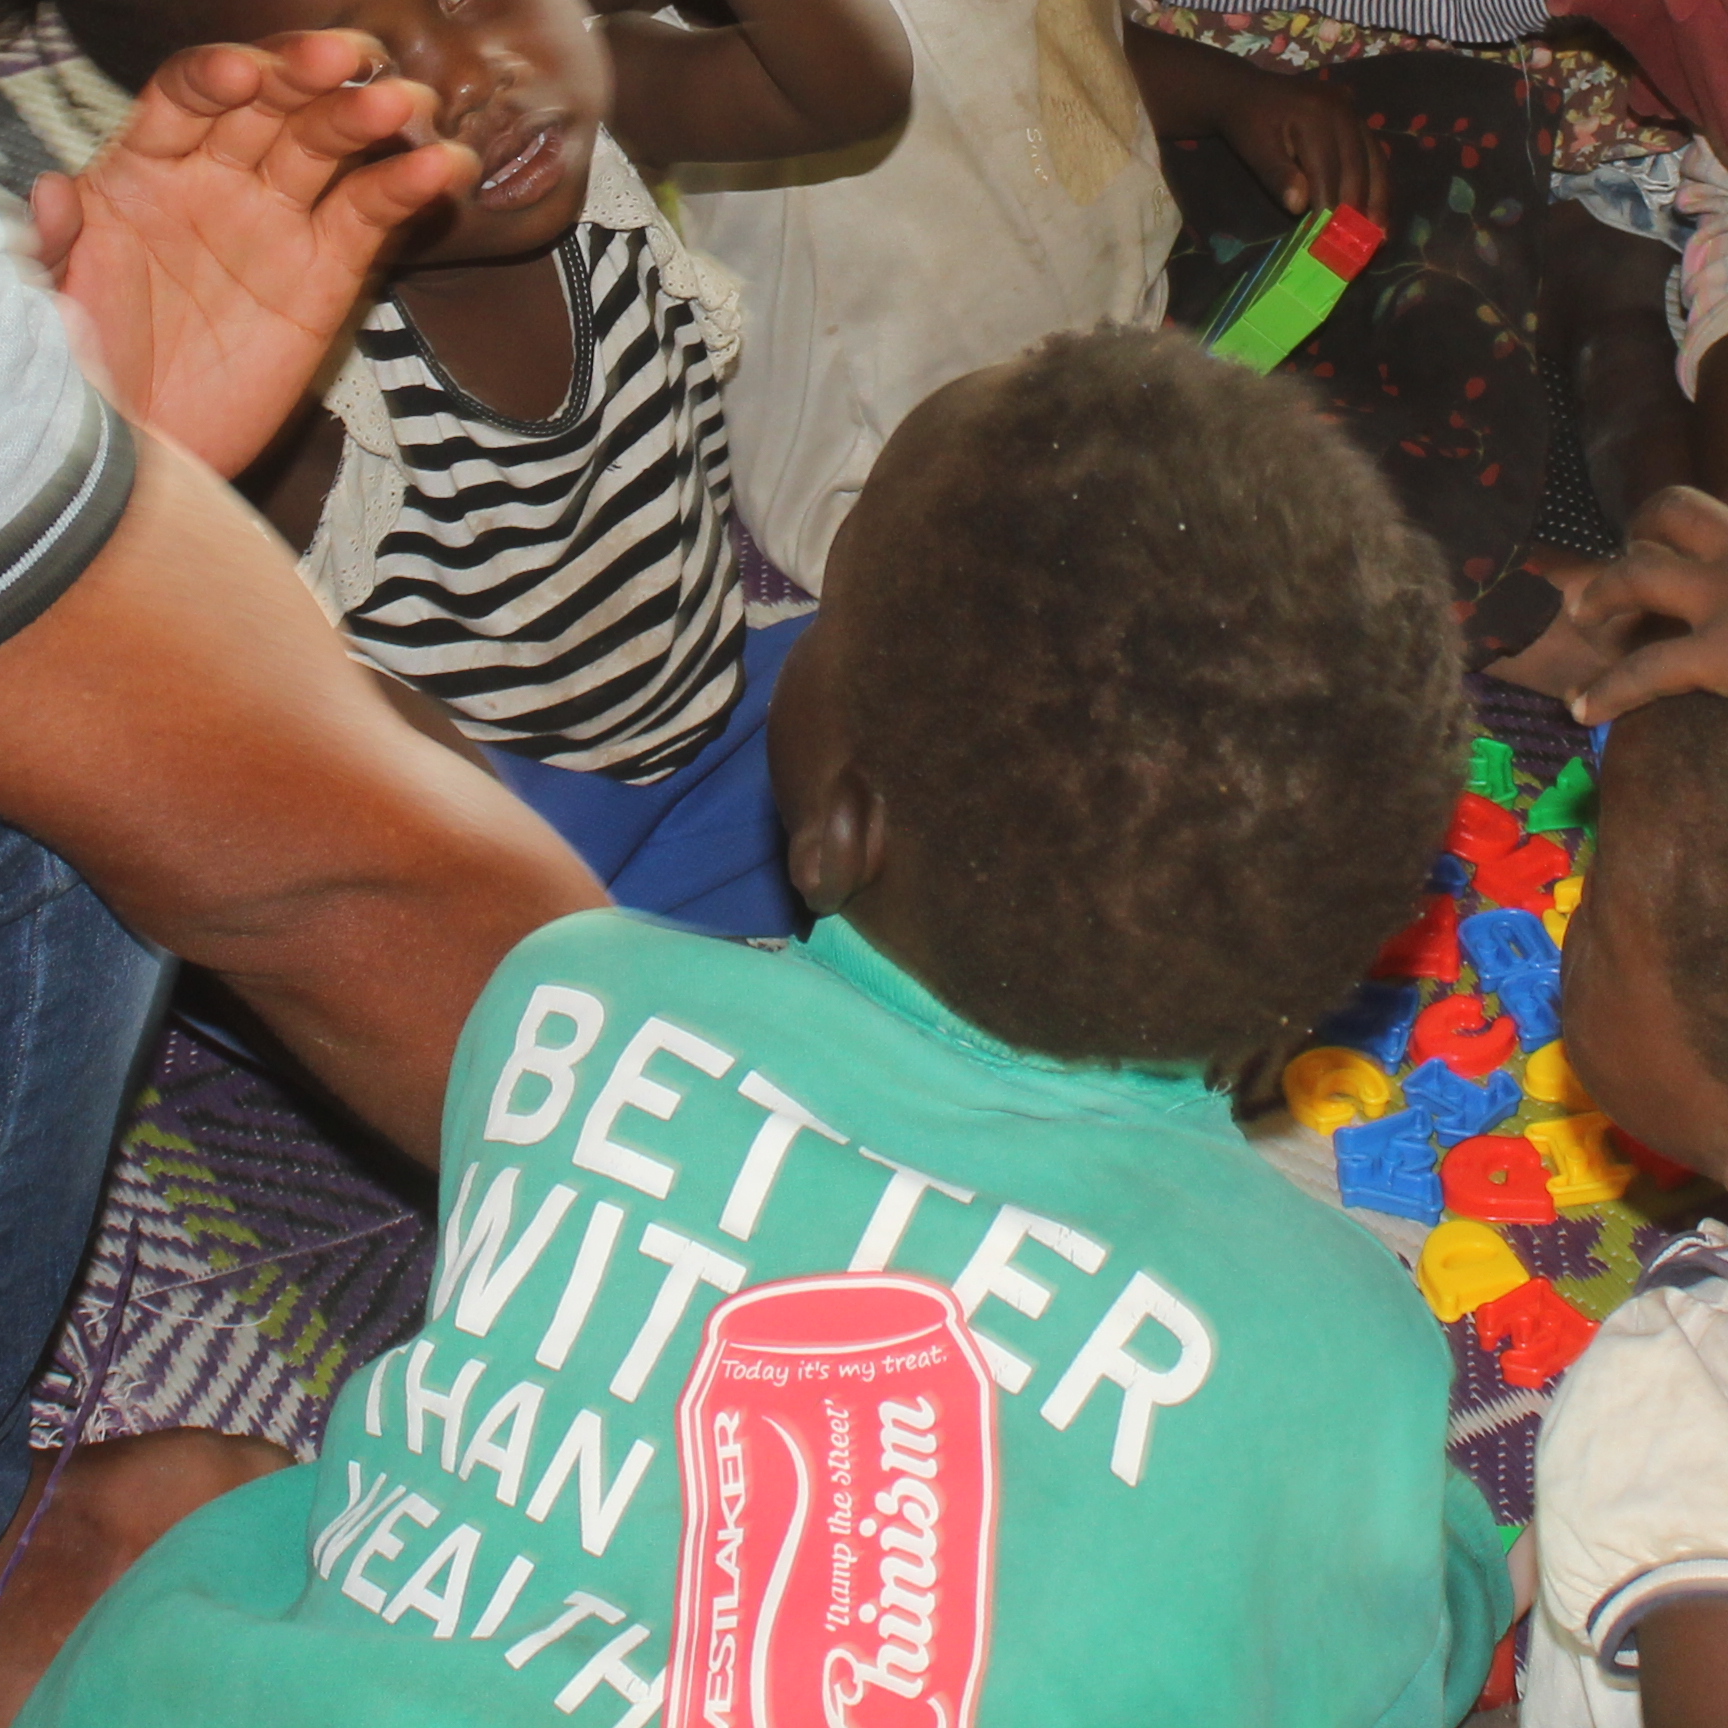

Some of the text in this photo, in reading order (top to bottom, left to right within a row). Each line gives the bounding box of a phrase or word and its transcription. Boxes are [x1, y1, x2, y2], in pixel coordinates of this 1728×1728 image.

[432, 1160, 748, 1404] WIT
[483, 984, 1214, 1488] BETTER
[721, 1344, 949, 1388] Today it's my treat.
[702, 1410, 746, 1728] ESTLAKER
